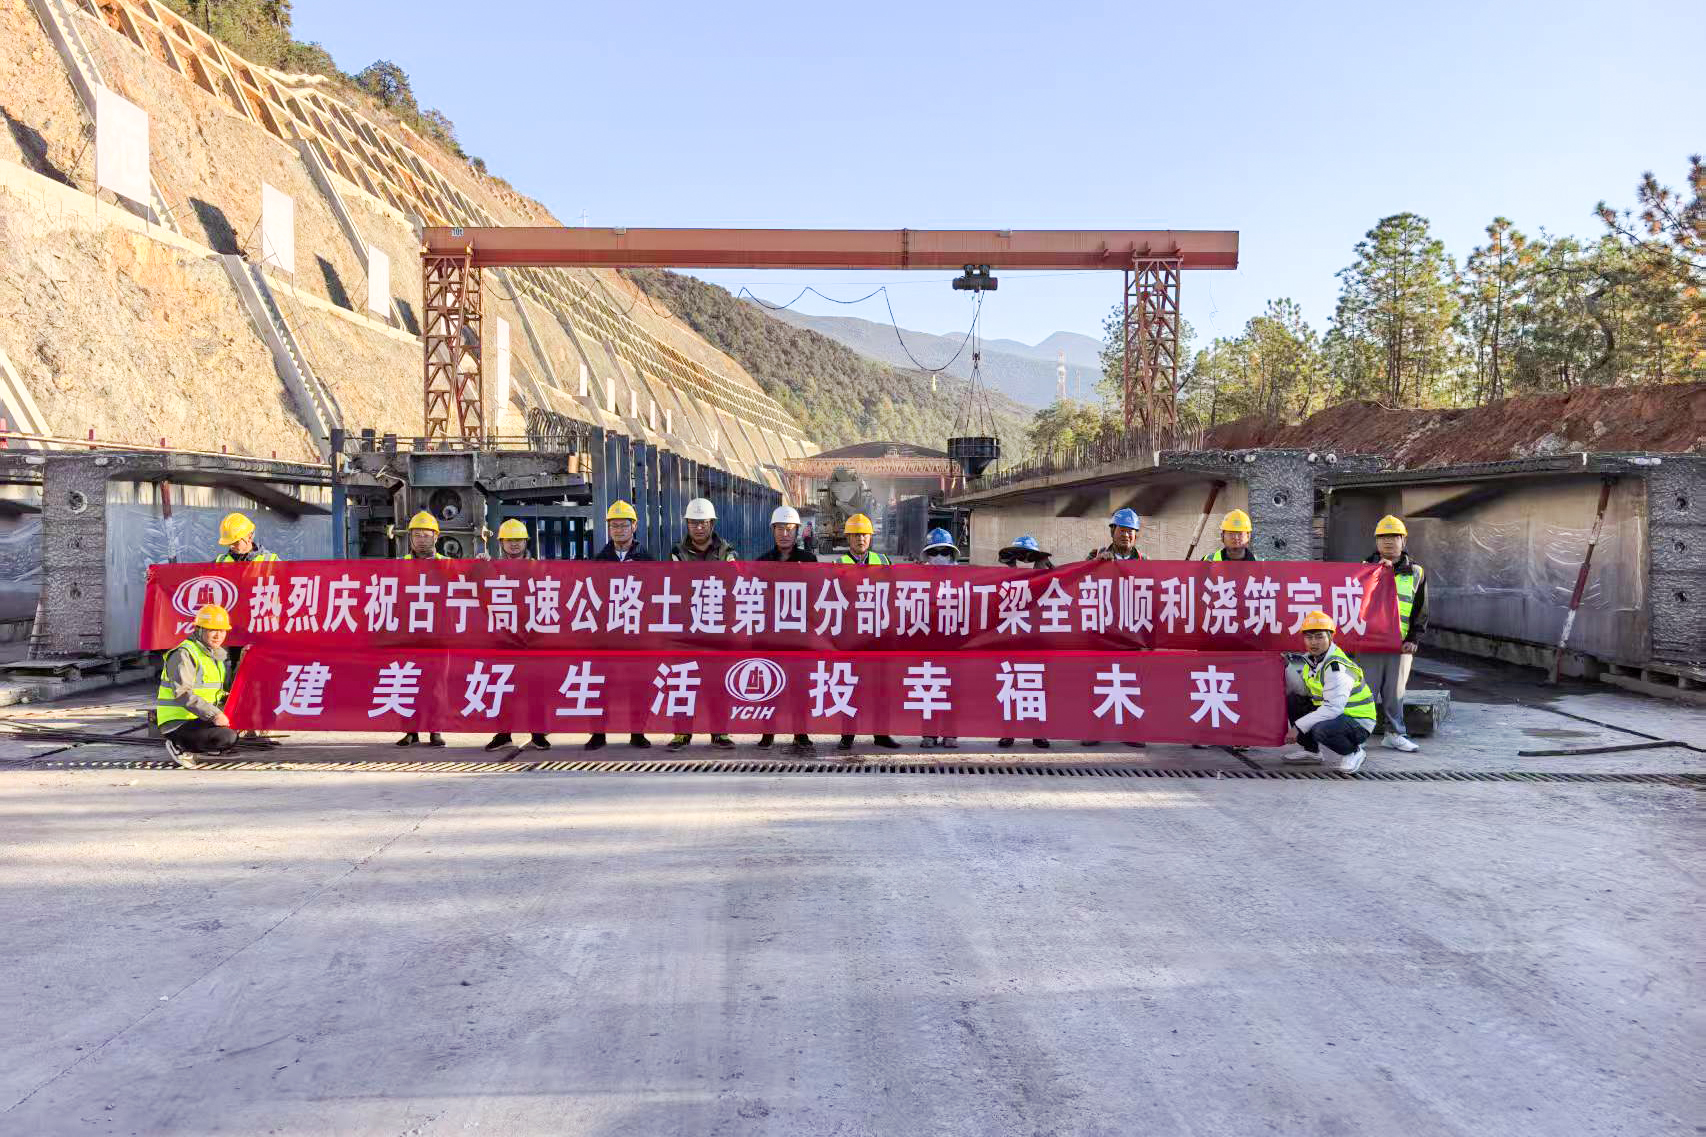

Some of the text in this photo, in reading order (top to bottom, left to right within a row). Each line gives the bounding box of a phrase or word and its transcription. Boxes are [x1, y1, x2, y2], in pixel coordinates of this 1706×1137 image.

[247, 573, 1367, 638] 热烈庆祝古宁高速公路土建第四分部预制T梁全部顺利浇筑完成
[274, 660, 1241, 728] 建美好生活 投幸福未来
[730, 706, 776, 720] YCIH
